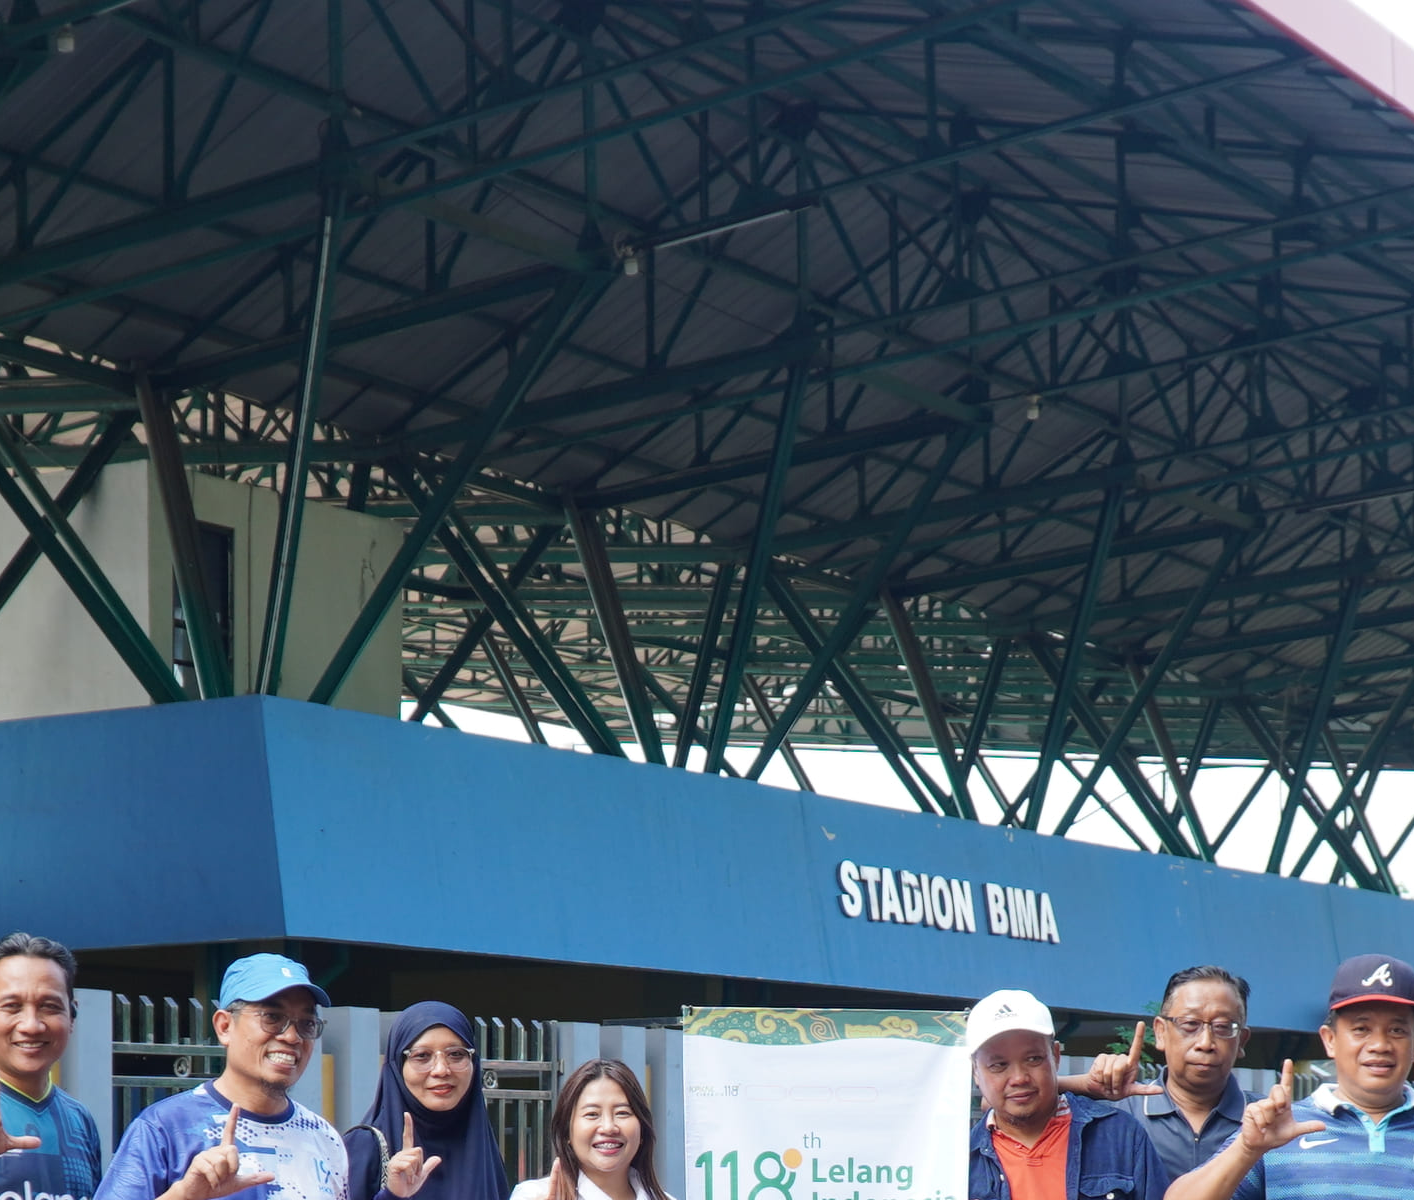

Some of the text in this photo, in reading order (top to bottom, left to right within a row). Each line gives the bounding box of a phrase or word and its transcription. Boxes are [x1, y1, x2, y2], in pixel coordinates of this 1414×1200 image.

[839, 859, 1060, 943] STADION BIMA
[812, 1157, 913, 1190] Lelang
